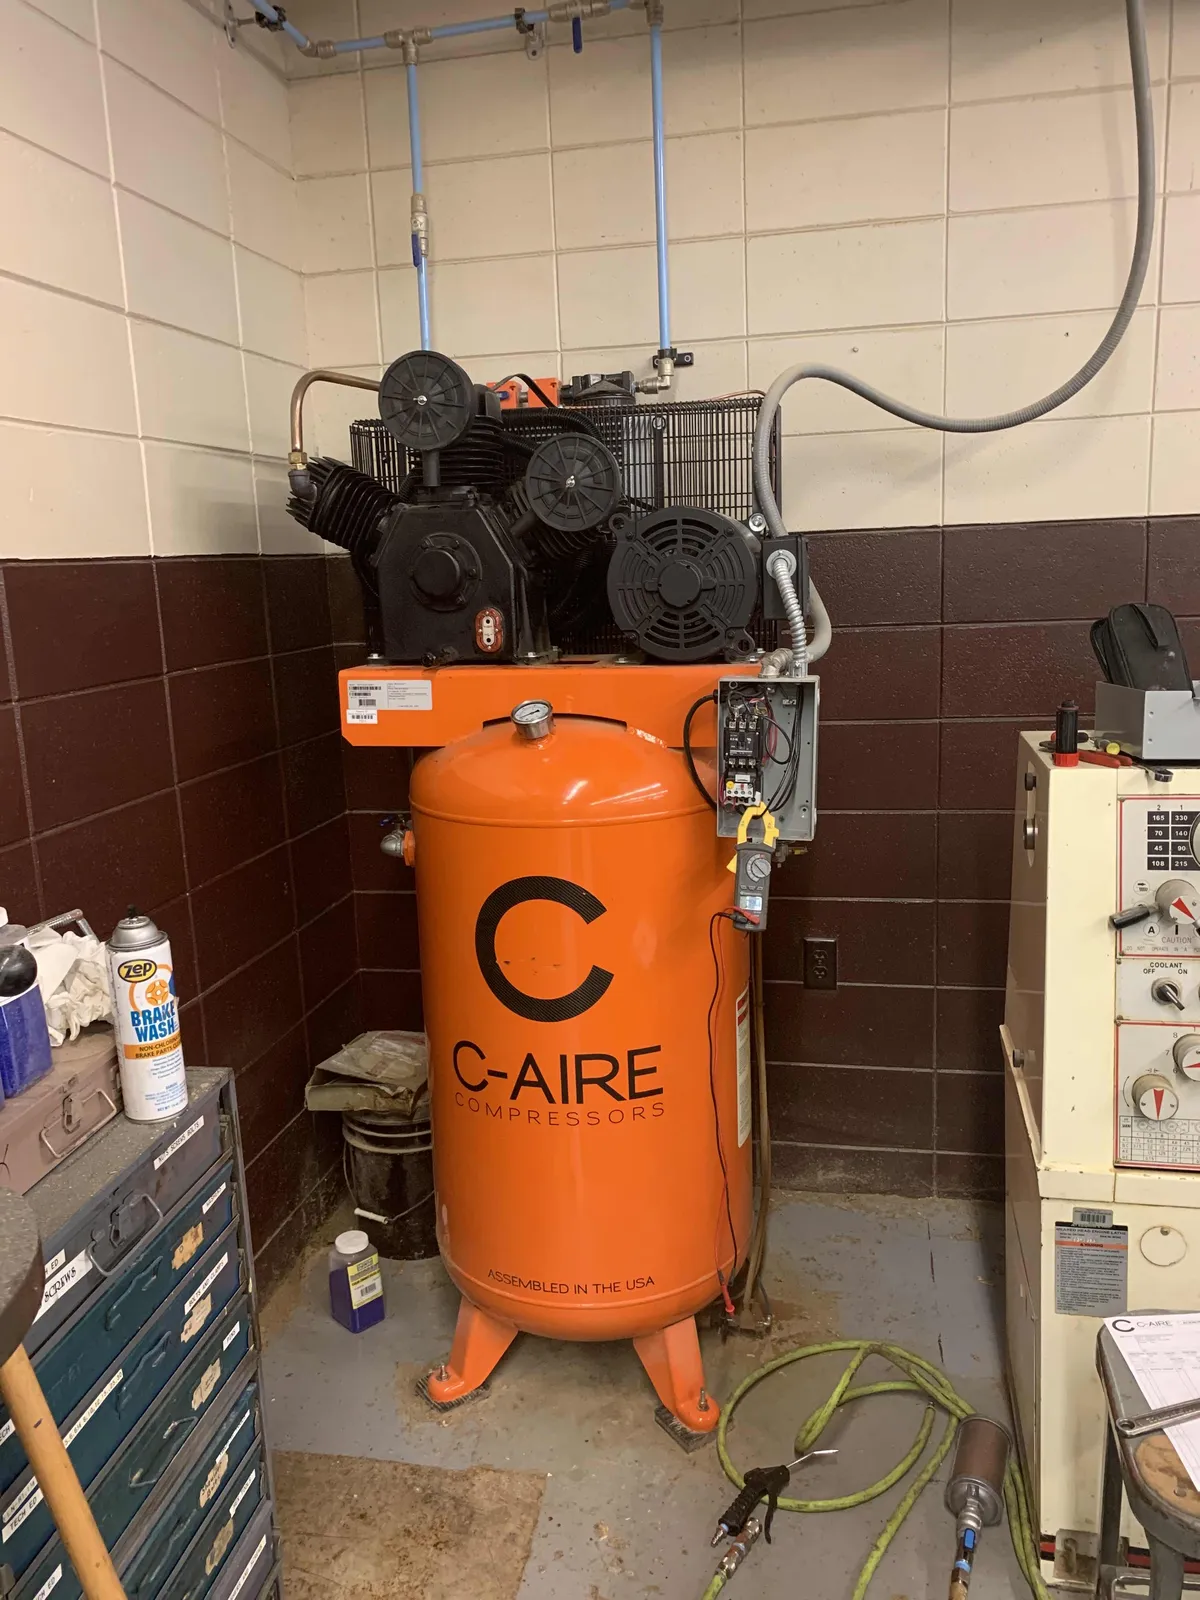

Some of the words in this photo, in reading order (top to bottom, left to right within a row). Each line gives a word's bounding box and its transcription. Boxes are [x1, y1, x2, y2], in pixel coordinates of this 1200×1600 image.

[130, 1001, 175, 1027] BRAKE
[134, 1018, 175, 1042] WASH
[136, 1050, 154, 1058] BRAKE
[156, 1046, 172, 1055] PARTS
[452, 1040, 664, 1104] C-AIRE
[454, 1092, 665, 1126] COMPRESSORS
[187, 1122, 200, 1137] BOLTS
[50, 1259, 58, 1270] ED
[44, 1266, 76, 1302] SCREWS
[488, 1268, 570, 1294] ASSEMBLED
[574, 1284, 588, 1294] IN
[592, 1282, 621, 1294] THE
[626, 1275, 655, 1290] USA
[10, 1511, 26, 1531] TECH
[28, 1496, 37, 1509] ED
[48, 1576, 55, 1589] ED
